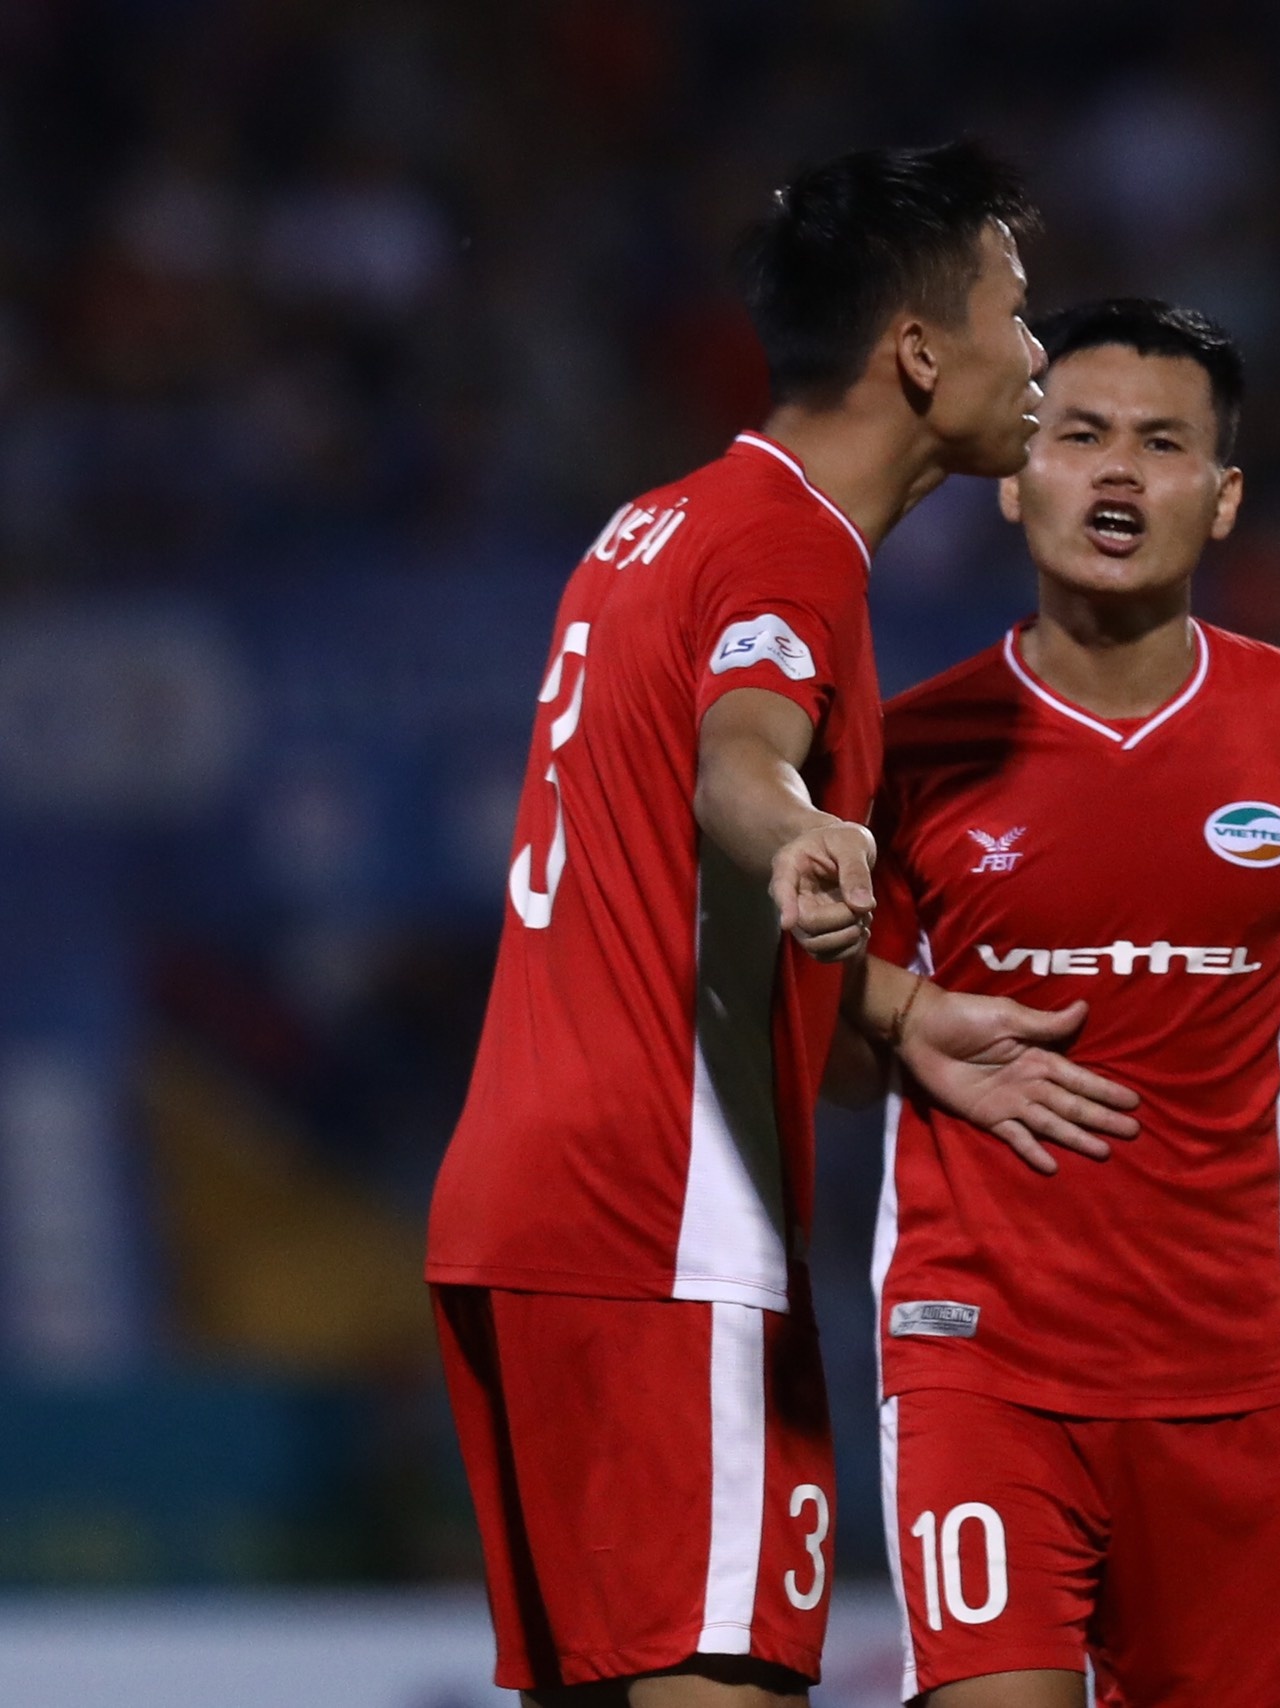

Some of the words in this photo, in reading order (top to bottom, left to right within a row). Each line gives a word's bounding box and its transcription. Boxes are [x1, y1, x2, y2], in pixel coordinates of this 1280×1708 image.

[719, 633, 759, 660] LS
[509, 621, 590, 929] 3
[971, 852, 1024, 873] FBT
[976, 940, 1262, 976] VIETTEL
[784, 1484, 829, 1611] 3
[911, 1502, 1008, 1631] 10
